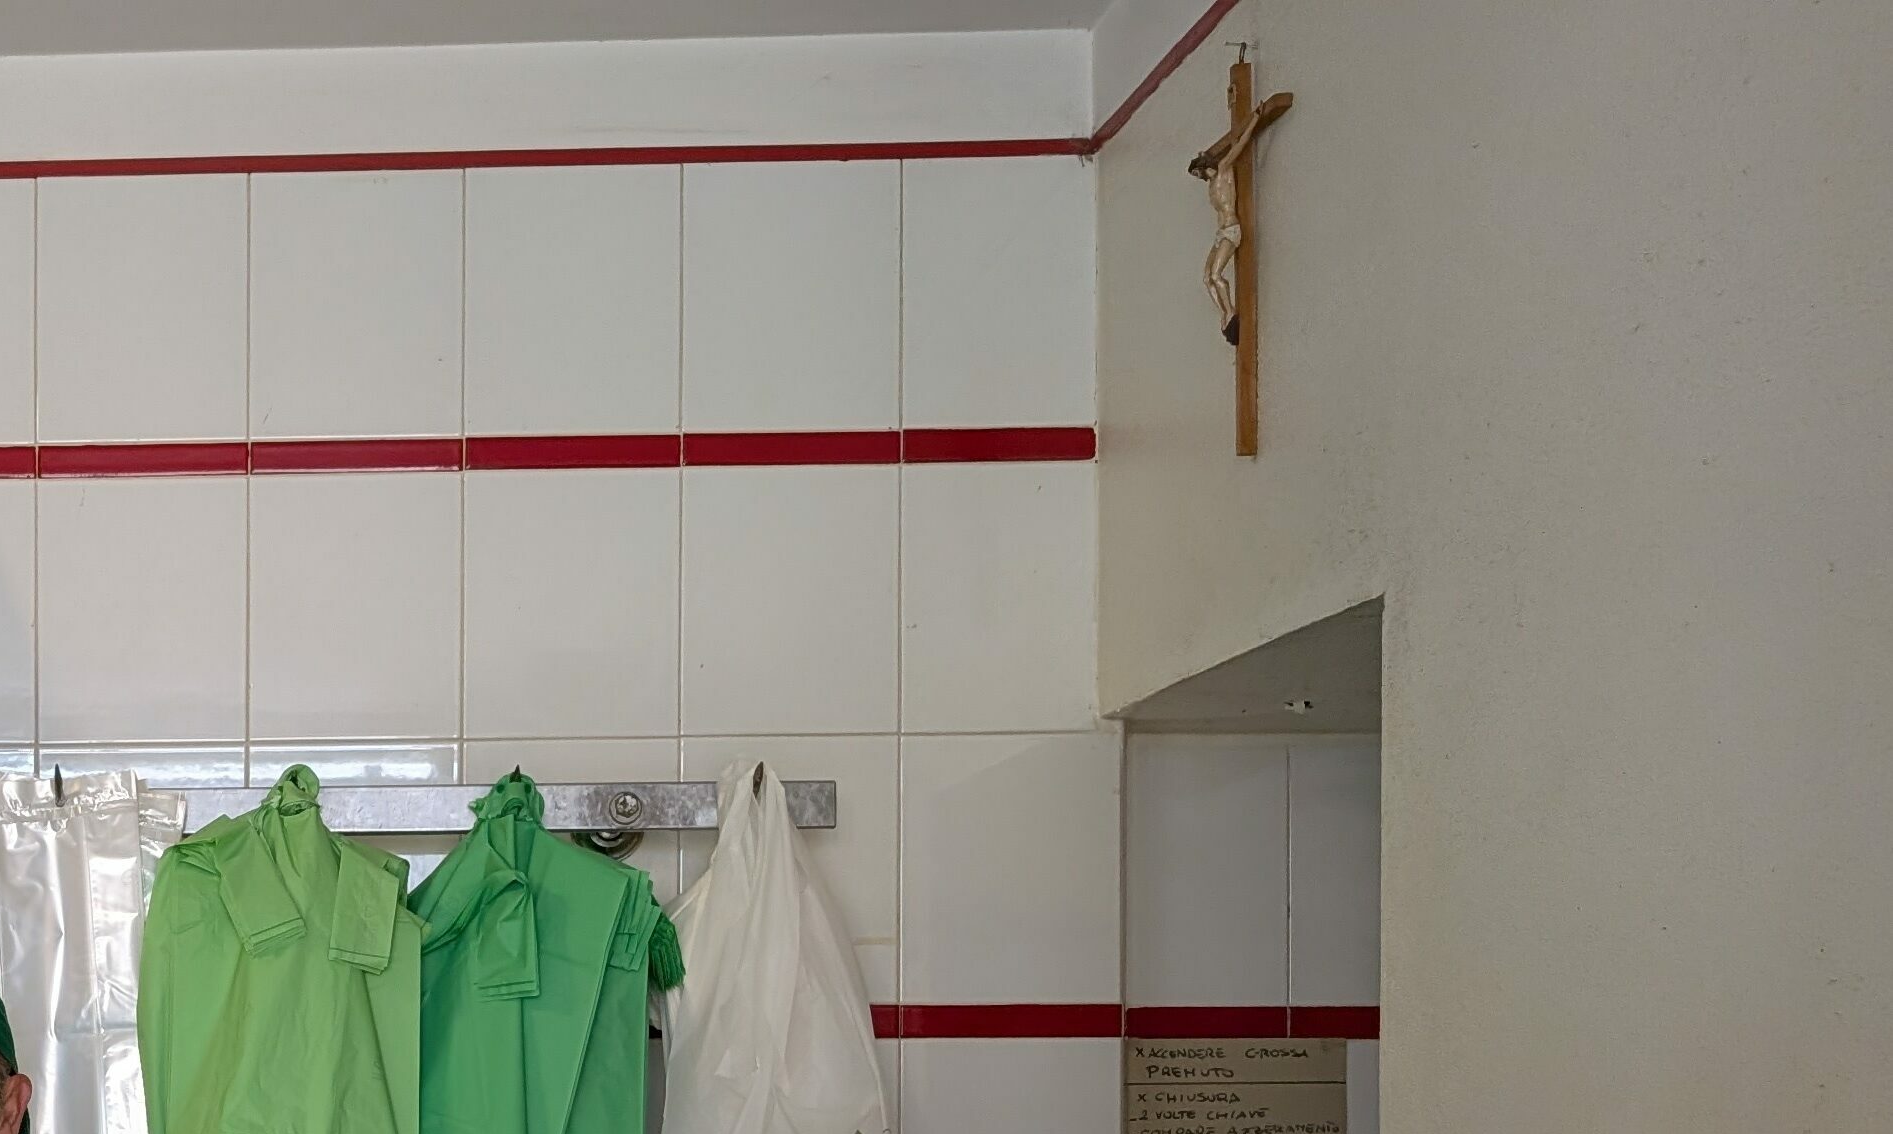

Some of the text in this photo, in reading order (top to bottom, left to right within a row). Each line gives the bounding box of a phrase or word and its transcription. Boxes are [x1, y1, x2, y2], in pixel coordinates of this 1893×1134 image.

[1155, 1093, 1240, 1102] CHIUSURA
[1156, 1108, 1269, 1120] VOLTE CHIAVE
